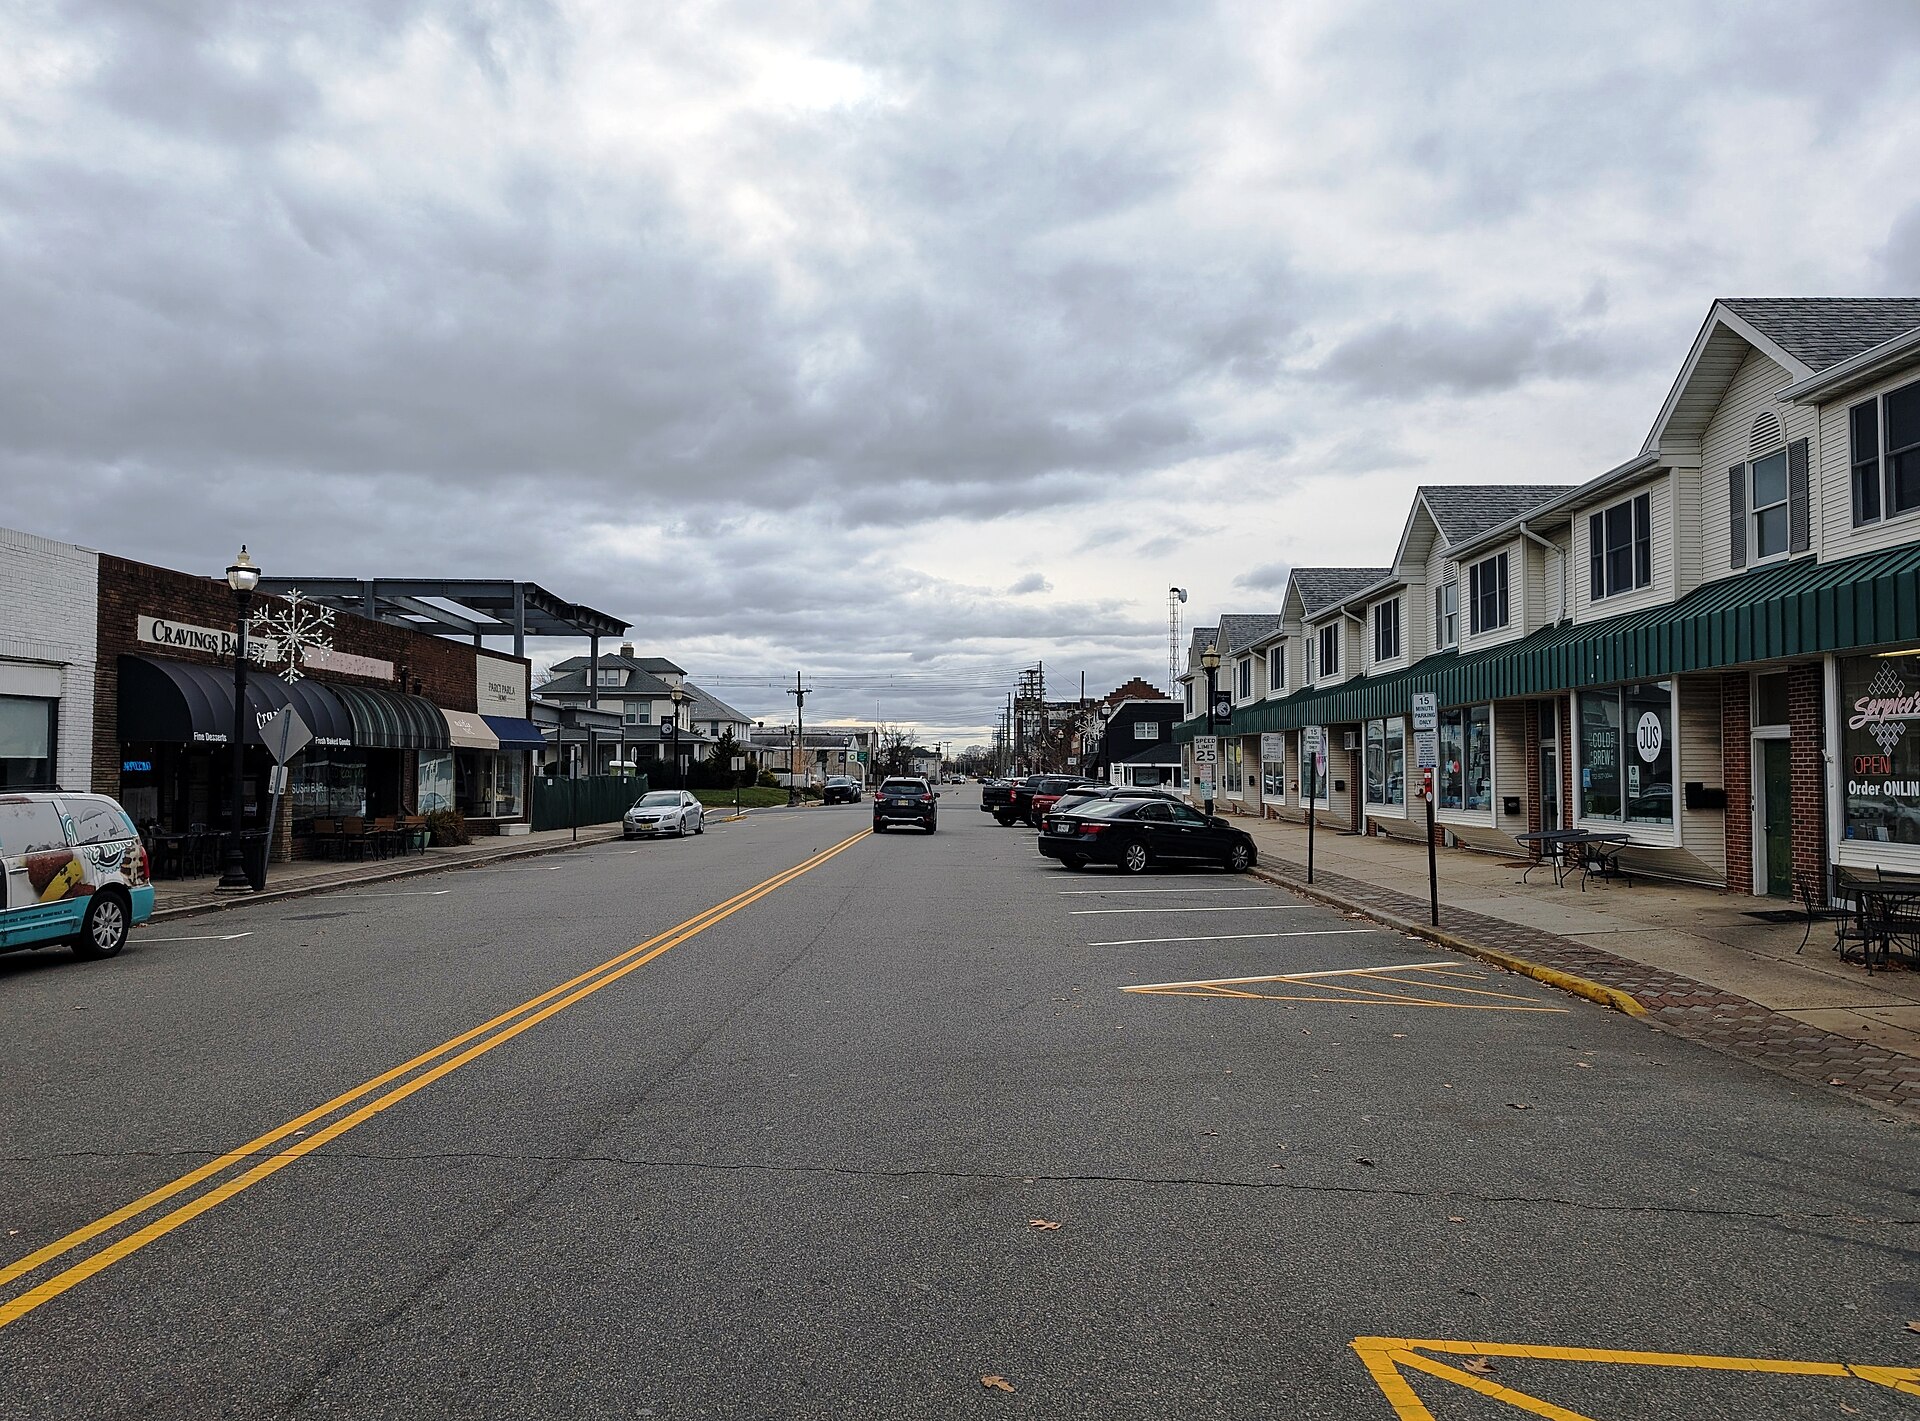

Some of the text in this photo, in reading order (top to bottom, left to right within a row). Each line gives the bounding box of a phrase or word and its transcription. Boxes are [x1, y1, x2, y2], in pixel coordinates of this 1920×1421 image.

[152, 619, 218, 650] CRAVINGS
[1419, 696, 1430, 705] 15
[193, 731, 228, 742] Fine Desserts
[1310, 728, 1318, 736] 15
[314, 736, 351, 746] Fresh Baked Goods
[1592, 732, 1611, 748] COLD
[1196, 750, 1216, 762] 25
[1593, 750, 1611, 766] BREW
[1855, 756, 1890, 774] OPEN
[291, 782, 325, 794] SUSHI BAR
[1848, 780, 1881, 796] Order
